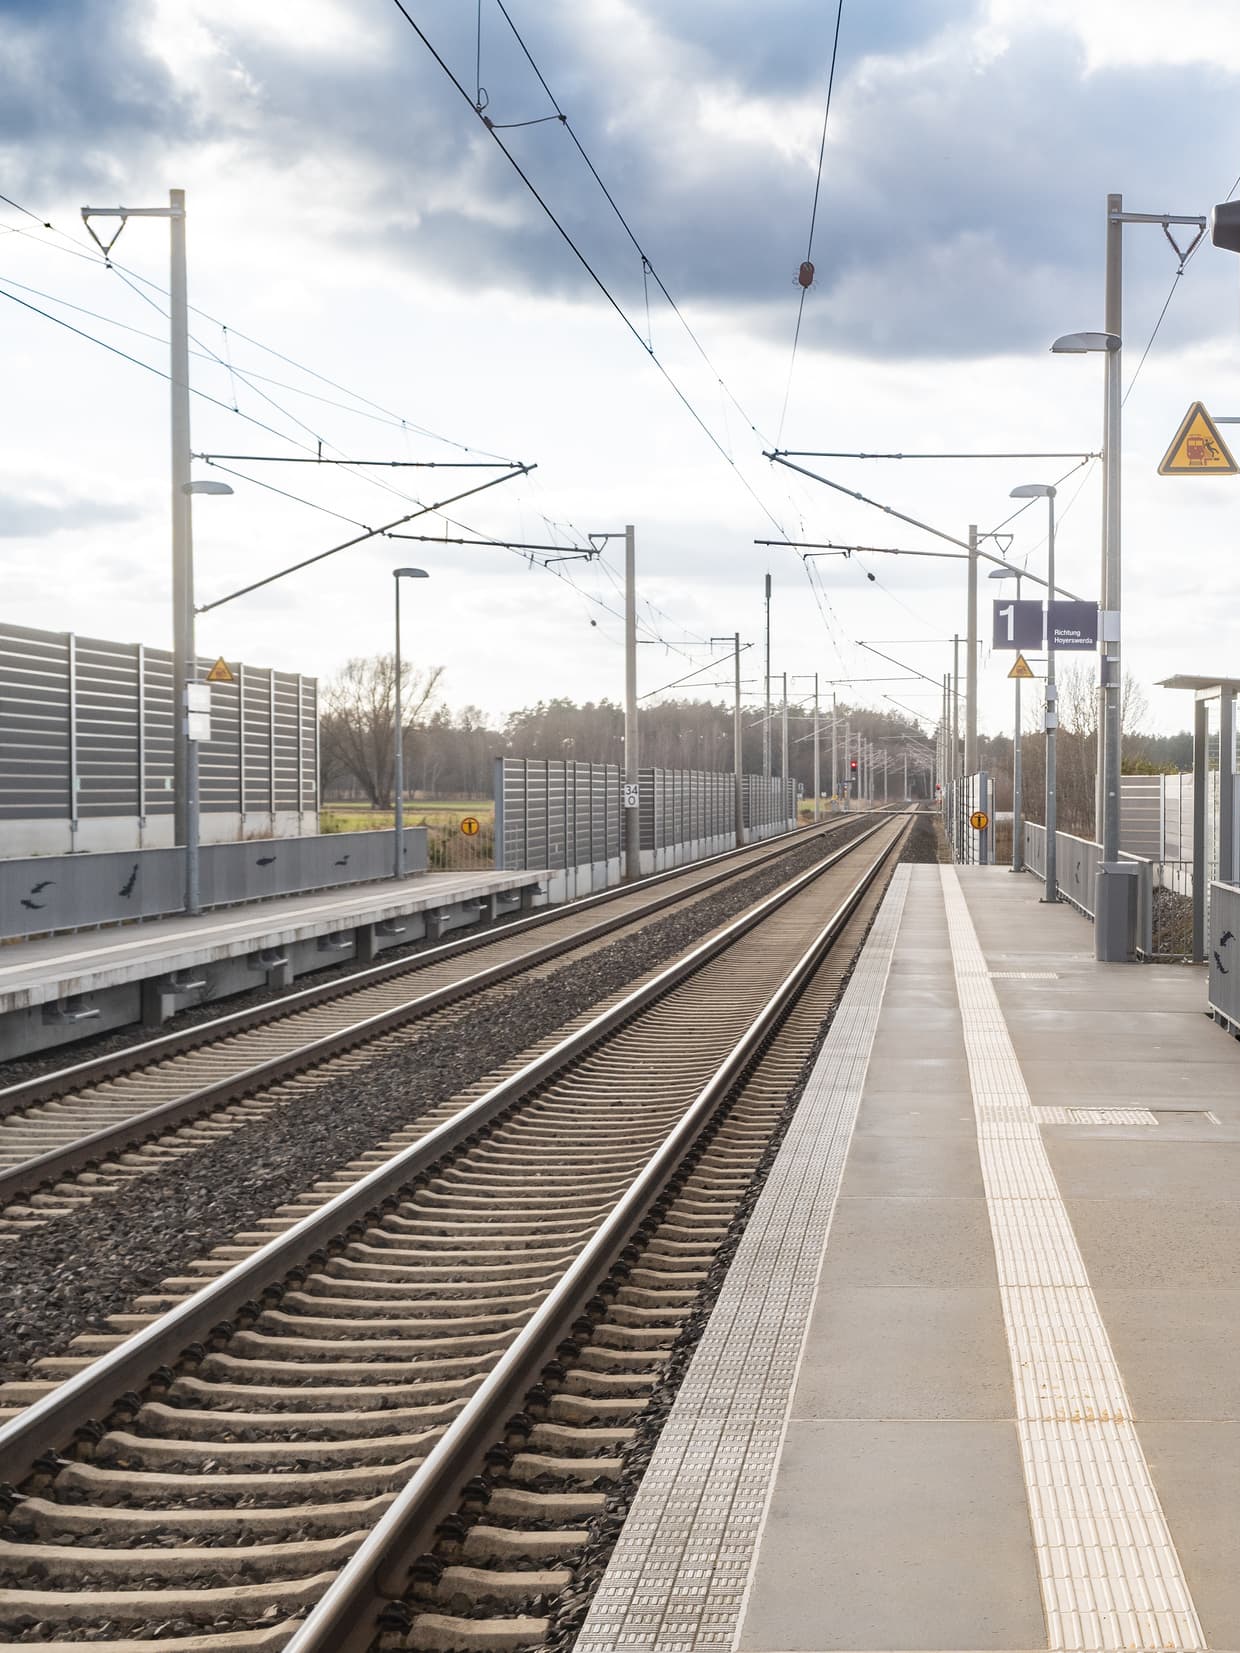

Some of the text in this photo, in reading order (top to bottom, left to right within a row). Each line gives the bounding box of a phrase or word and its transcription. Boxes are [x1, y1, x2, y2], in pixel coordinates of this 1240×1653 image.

[999, 605, 1015, 641] 1
[1054, 629, 1081, 637] Richtung
[626, 786, 637, 795] 34
